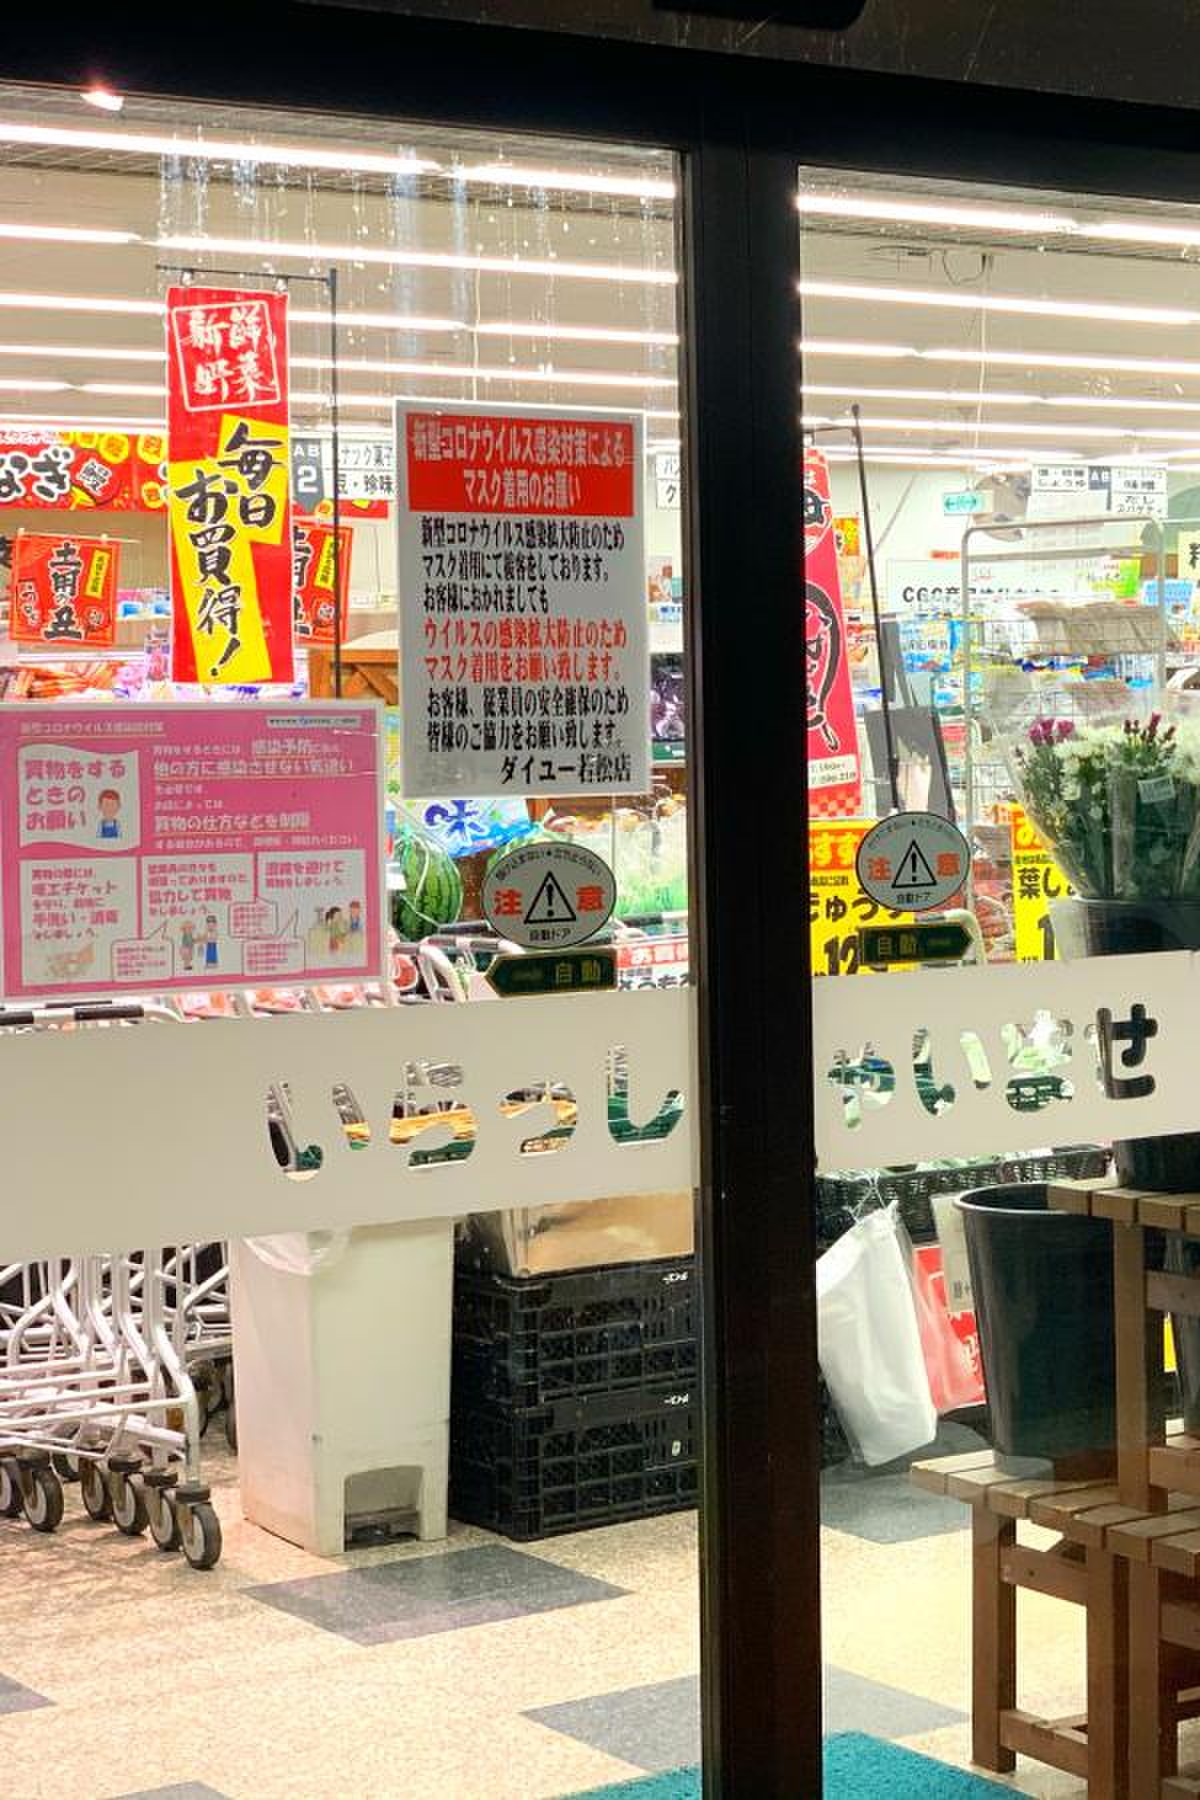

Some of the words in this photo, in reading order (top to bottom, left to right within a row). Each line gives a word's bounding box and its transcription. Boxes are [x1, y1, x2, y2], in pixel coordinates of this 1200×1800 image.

[184, 303, 265, 355] 新鮮
[193, 350, 275, 401] 野菜
[337, 446, 393, 467] ナック菓子
[218, 422, 285, 529] 毎日
[297, 464, 319, 493] 2
[463, 468, 582, 509] マスク着用のお願い
[421, 515, 625, 551] 新型コロナウイルス感染拡大防止のため
[424, 583, 549, 615] お客様におかれましても
[424, 618, 628, 650] ウイルスの感染拡大防止のため
[424, 652, 621, 684] マスク着用をお願い致します。
[26, 785, 87, 806] ときの
